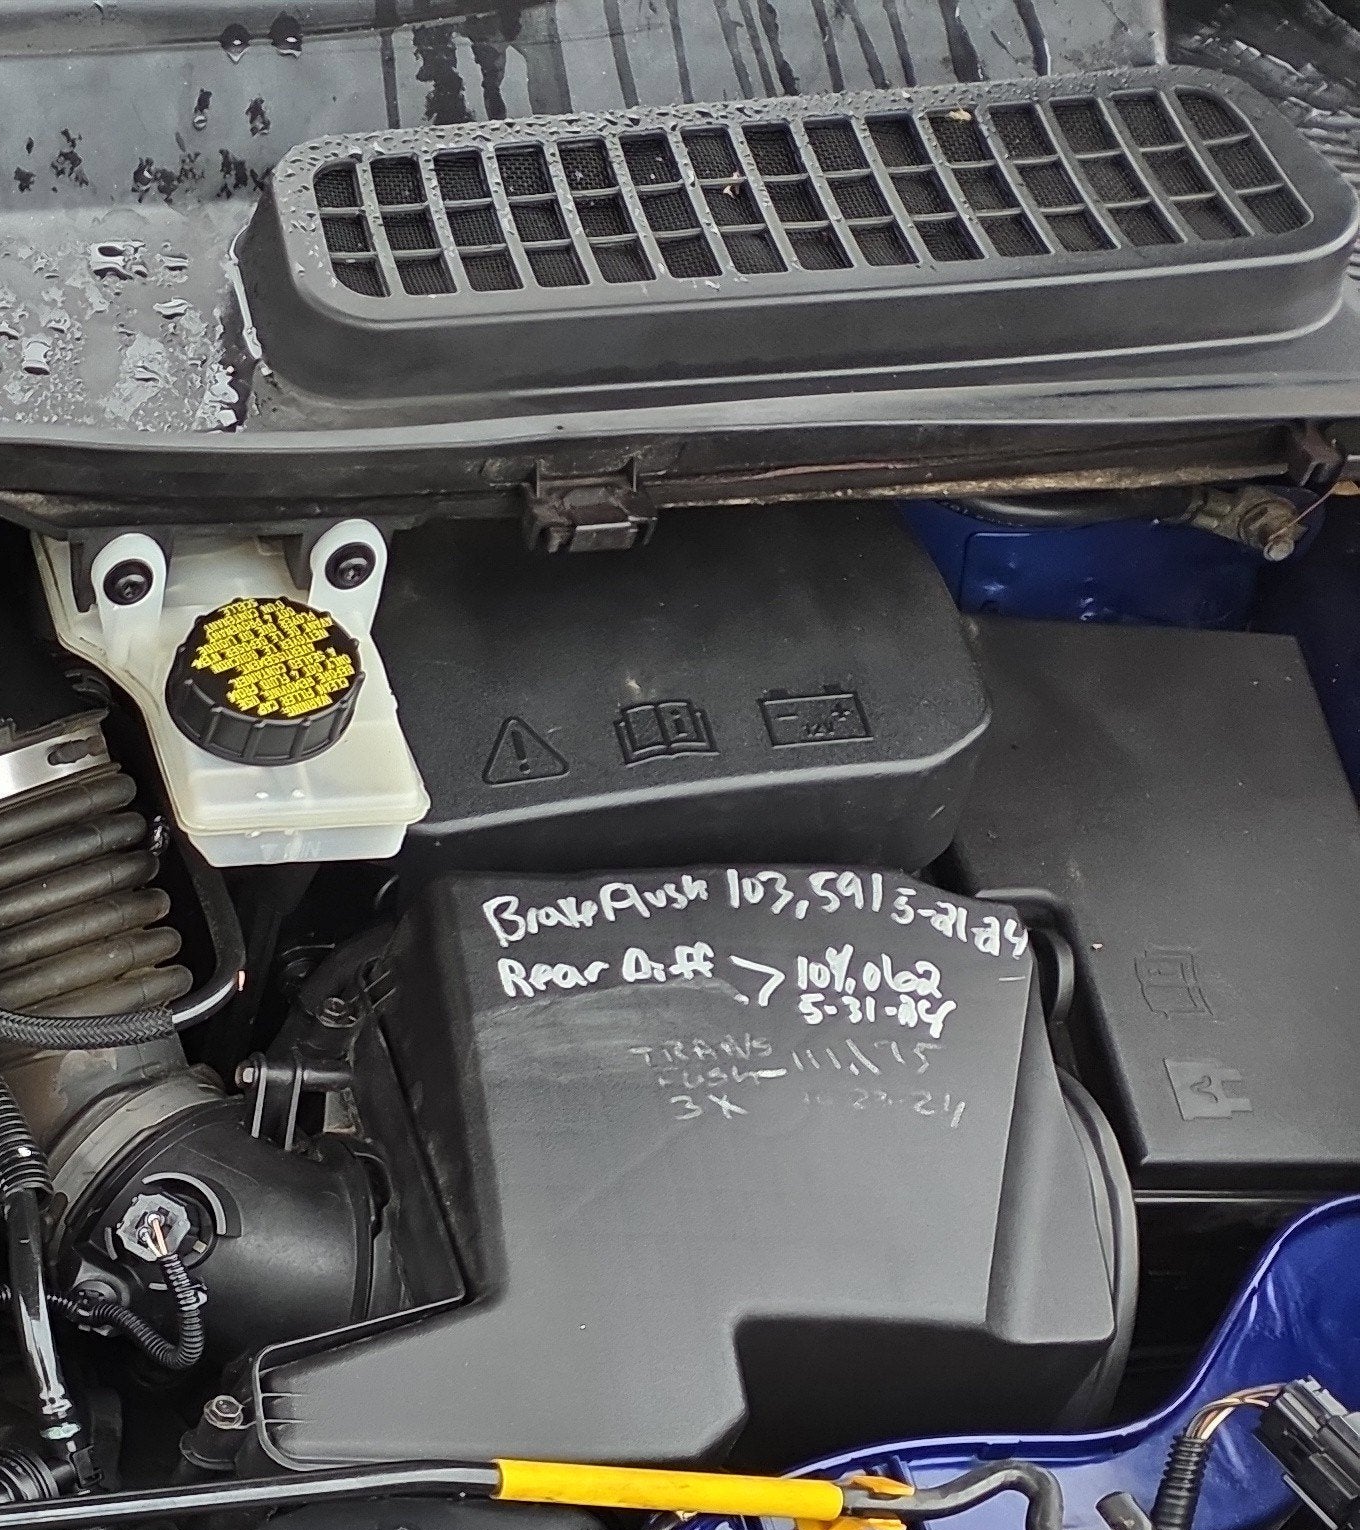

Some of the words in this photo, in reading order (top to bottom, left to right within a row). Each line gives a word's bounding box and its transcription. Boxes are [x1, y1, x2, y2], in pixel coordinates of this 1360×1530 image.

[288, 651, 325, 668] SEALED
[324, 654, 352, 669] ONLY
[302, 663, 323, 676] DOT
[316, 664, 355, 684] BEFORE
[259, 673, 290, 690] FLUID
[316, 678, 349, 694] CLEAN
[279, 688, 315, 706] FILLER
[257, 700, 279, 715] CAP
[726, 869, 883, 919] 103,591
[497, 958, 610, 998] Rear
[622, 941, 714, 983] Diff
[629, 1032, 773, 1066] TRANS
